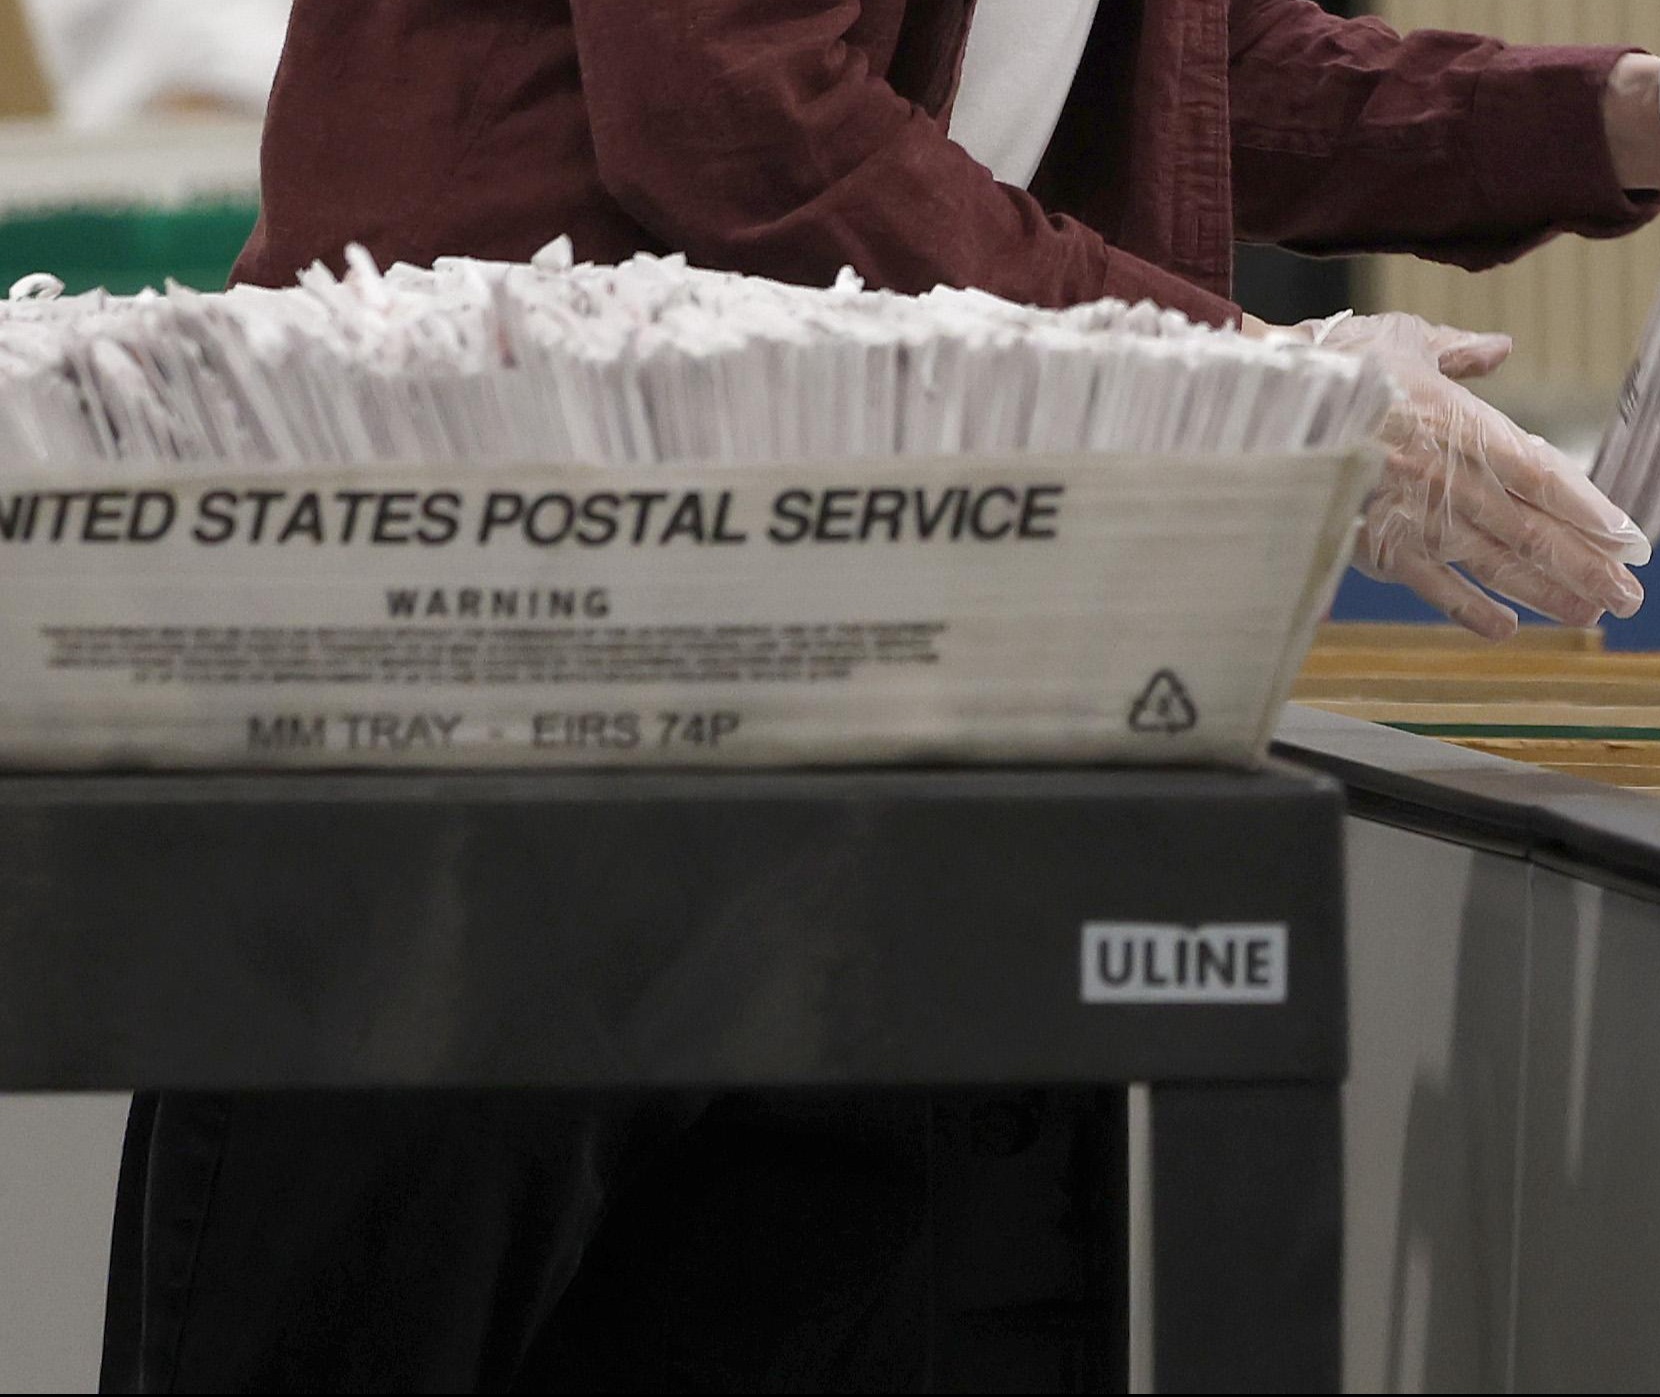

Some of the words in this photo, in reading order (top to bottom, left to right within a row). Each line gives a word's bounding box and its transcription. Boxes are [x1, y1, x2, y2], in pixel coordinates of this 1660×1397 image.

[193, 490, 461, 545] STATES
[478, 491, 749, 545] POSTAL
[768, 486, 1064, 543] SERVICE
[386, 589, 611, 618] WARNING
[249, 714, 326, 750] MM
[341, 713, 463, 750] TRAY
[532, 712, 641, 749] EIRS
[657, 712, 740, 747] 74P
[1097, 937, 1269, 987] ULINE
